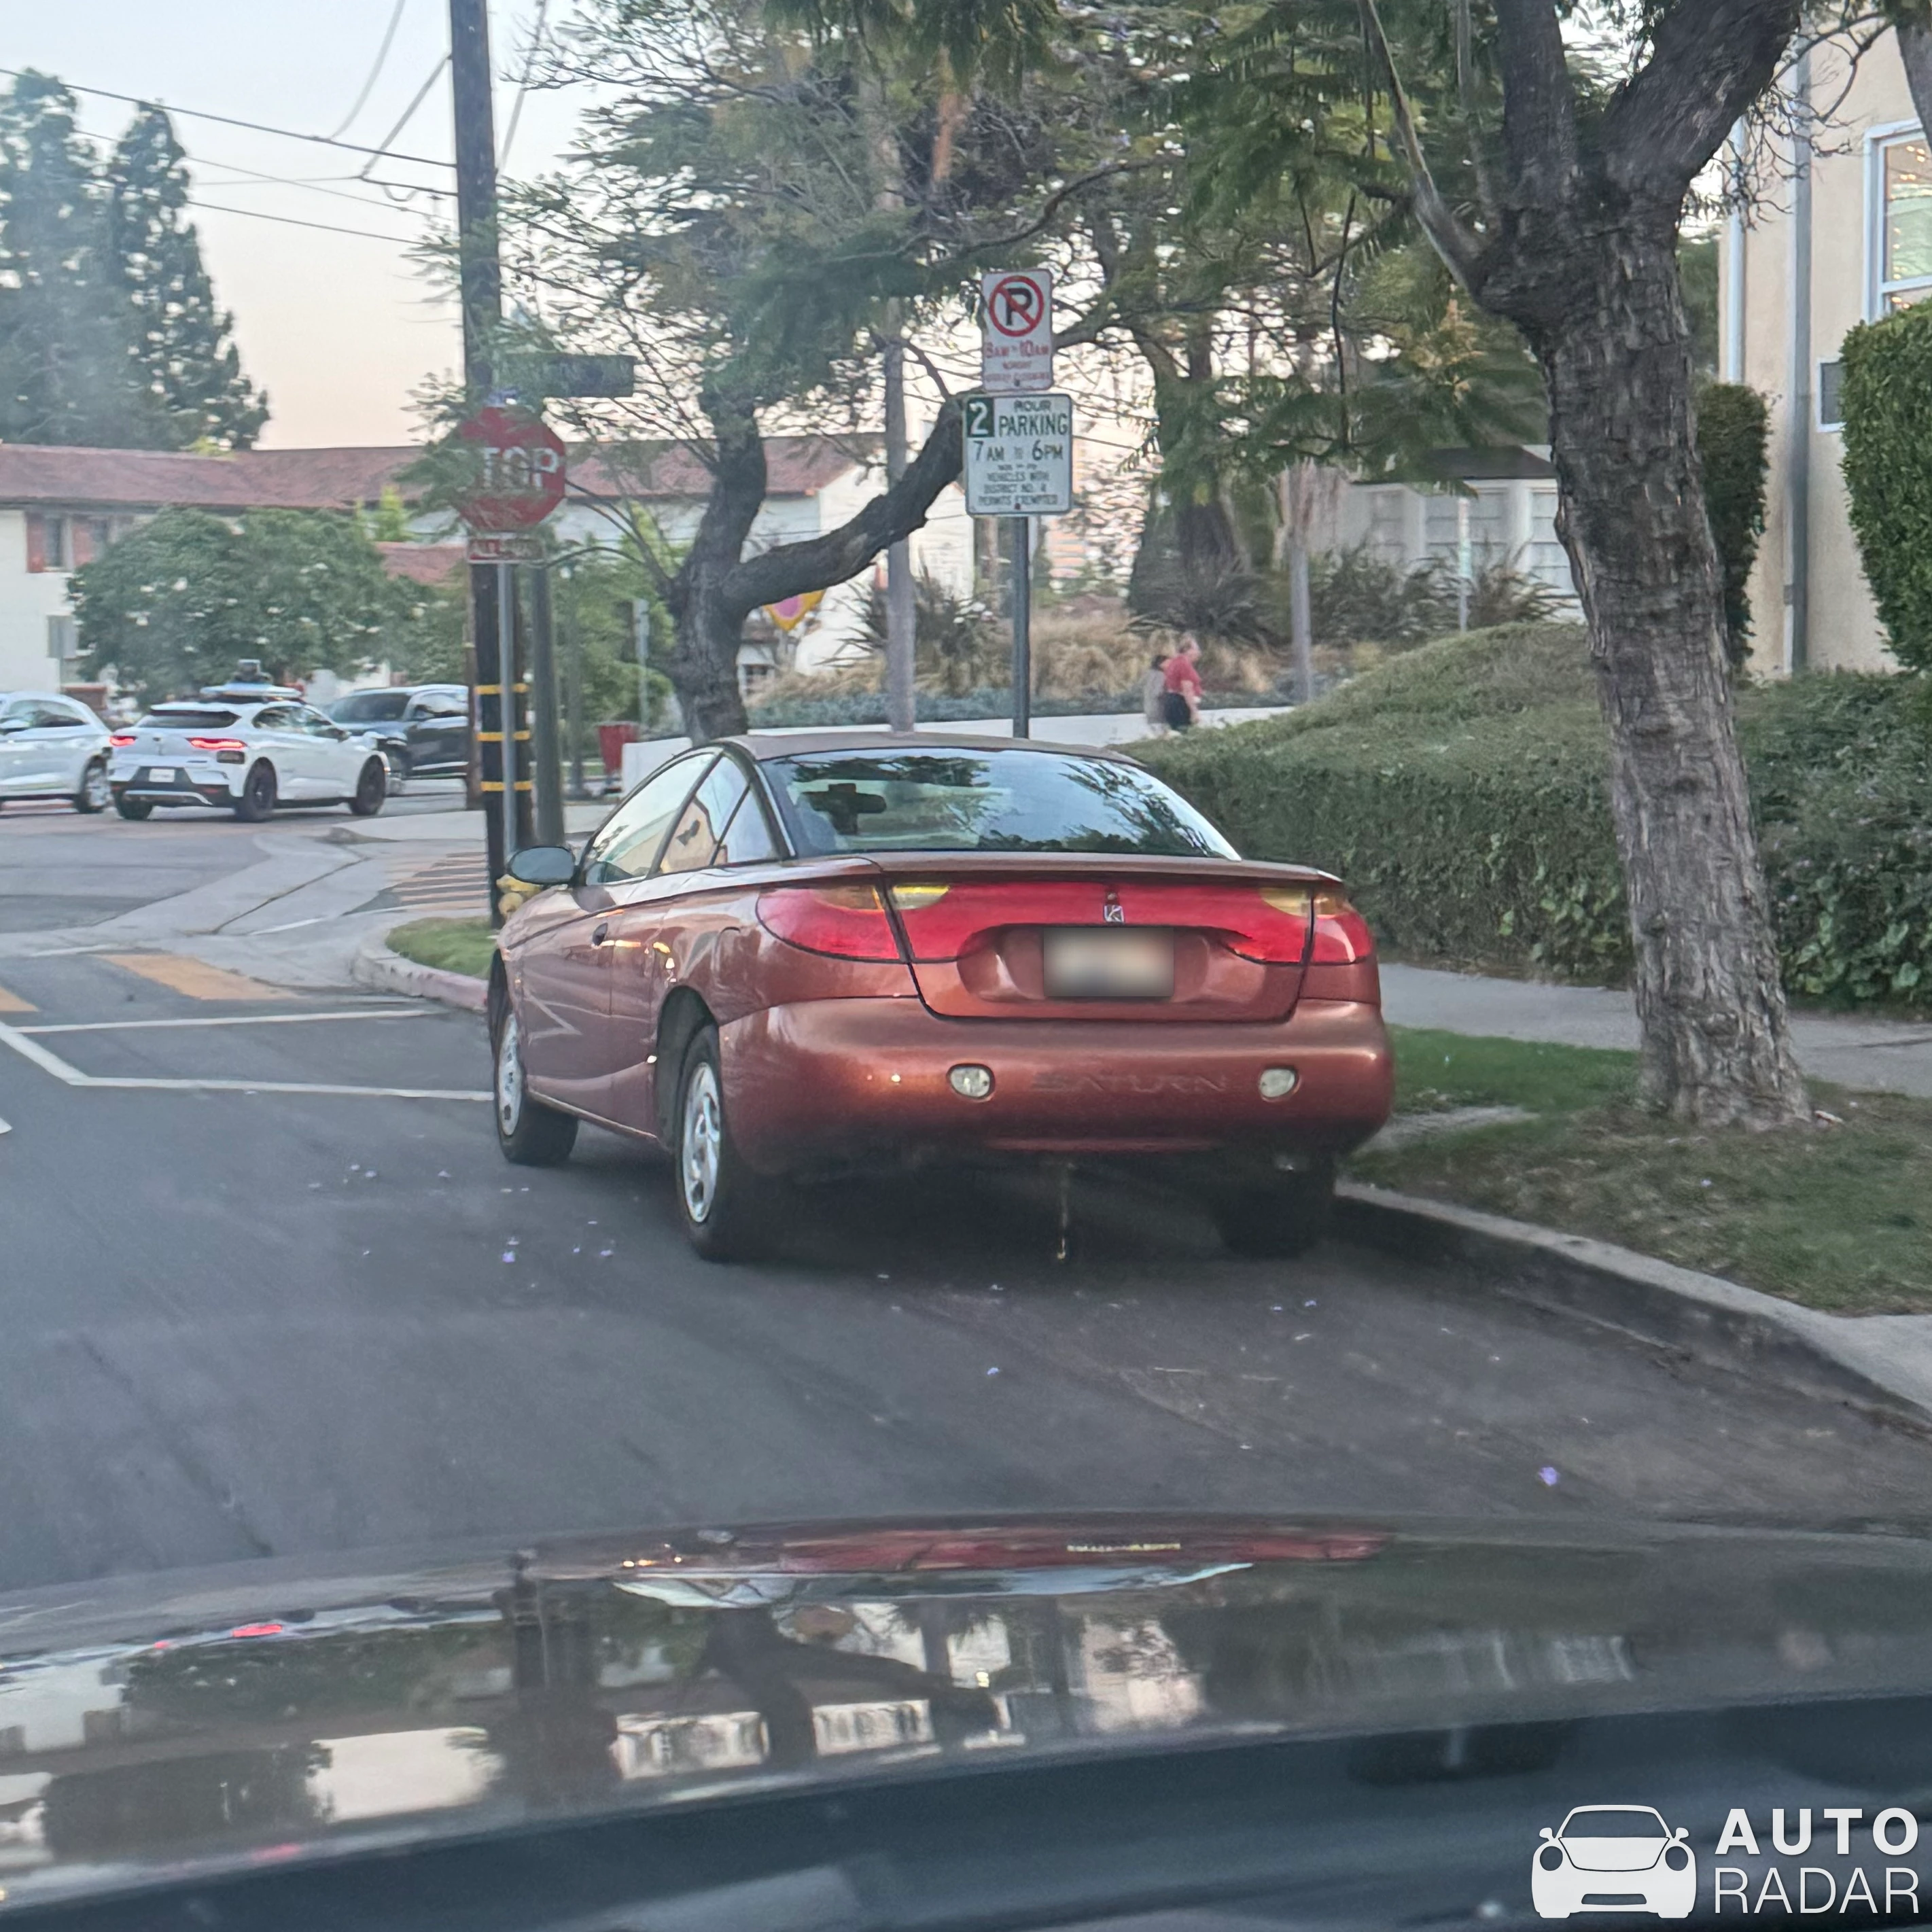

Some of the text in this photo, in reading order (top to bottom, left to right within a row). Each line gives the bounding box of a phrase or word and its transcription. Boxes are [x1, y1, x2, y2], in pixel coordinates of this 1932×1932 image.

[969, 402, 989, 435] 2
[1014, 400, 1051, 412] HOUR
[999, 413, 1068, 437] PARKING
[480, 445, 559, 489] TOP
